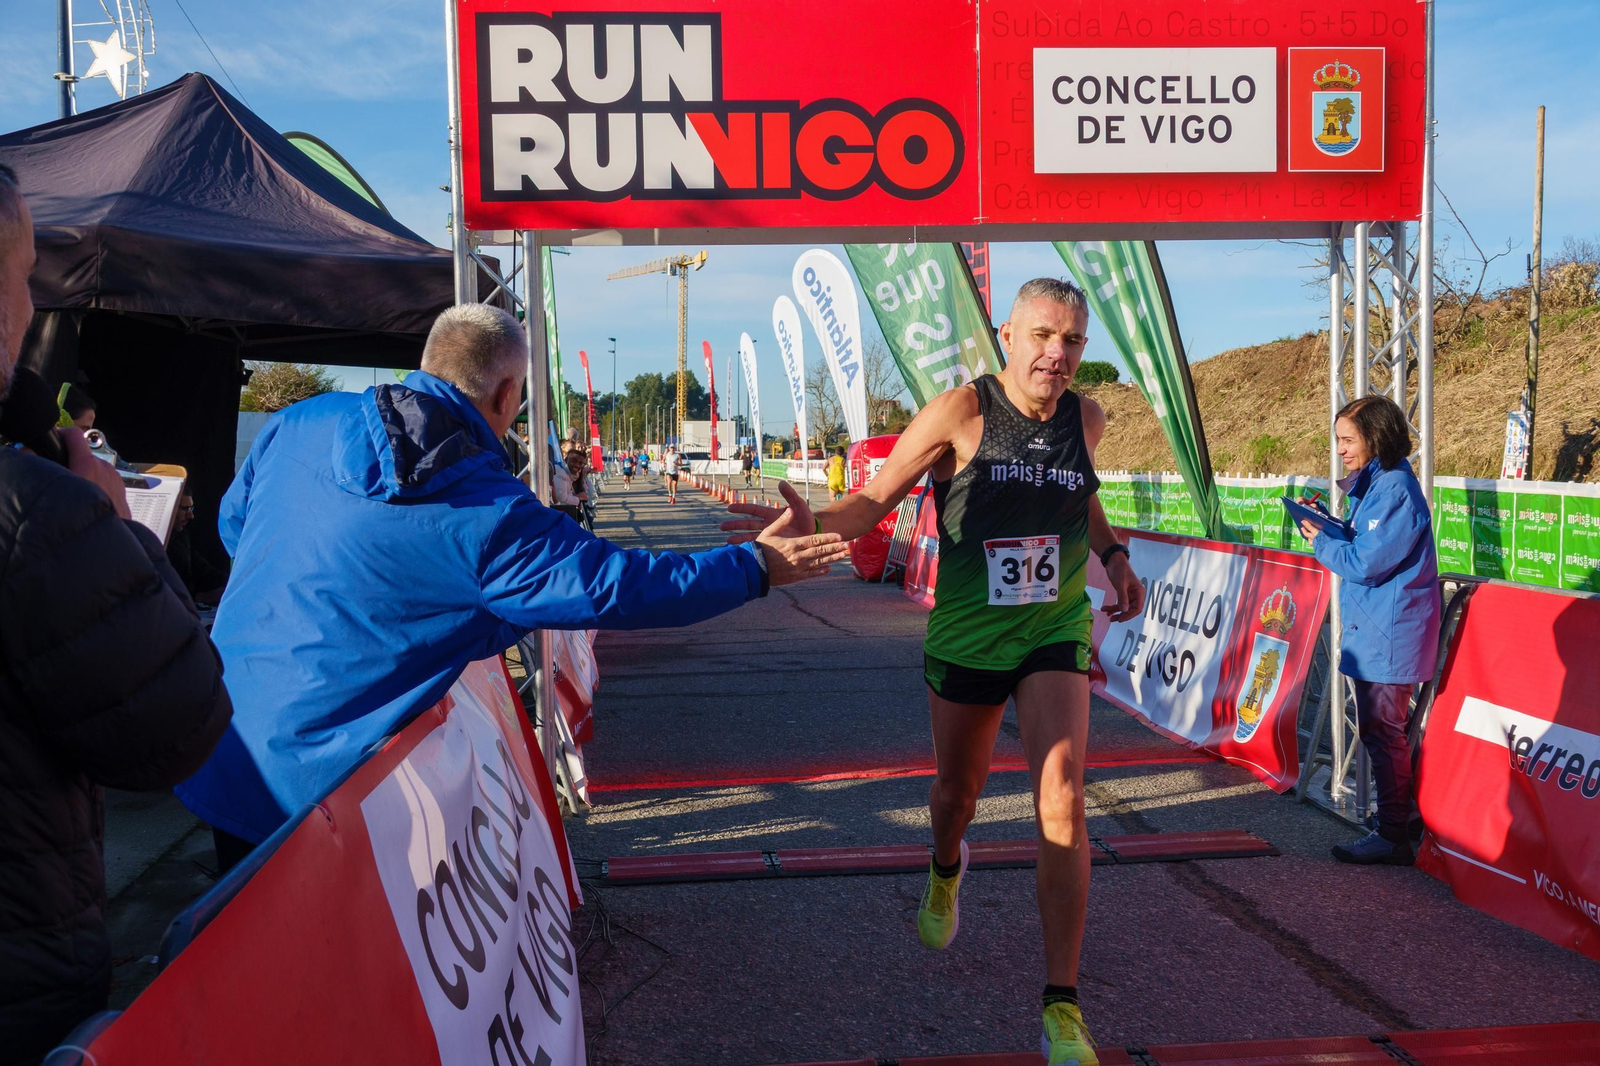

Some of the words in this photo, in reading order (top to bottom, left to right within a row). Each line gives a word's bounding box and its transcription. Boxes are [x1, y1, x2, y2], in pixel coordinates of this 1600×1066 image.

[992, 11, 1102, 38] Subida
[1114, 11, 1159, 38] Ao
[1167, 11, 1271, 38] Castro
[1299, 11, 1358, 38] 5+5
[1370, 11, 1409, 38] Do
[489, 24, 712, 103] RUN
[1052, 75, 1256, 105] CONCELLO
[1077, 115, 1126, 144] DE
[1140, 114, 1233, 144] VIGO
[993, 183, 1107, 211] Cáncer
[1135, 183, 1204, 215] Vigo
[1218, 182, 1263, 208] +11
[1293, 182, 1327, 208] La
[1339, 182, 1370, 208] 21
[1028, 443, 1050, 451] amura
[991, 459, 1033, 482] máis
[1035, 463, 1044, 487] que
[1046, 468, 1084, 491] auga
[1001, 555, 1055, 585] 316
[1140, 577, 1222, 639] NCELLO
[1115, 629, 1147, 673] DE
[1146, 638, 1195, 693] VIGO
[517, 867, 575, 1026] VIGO
